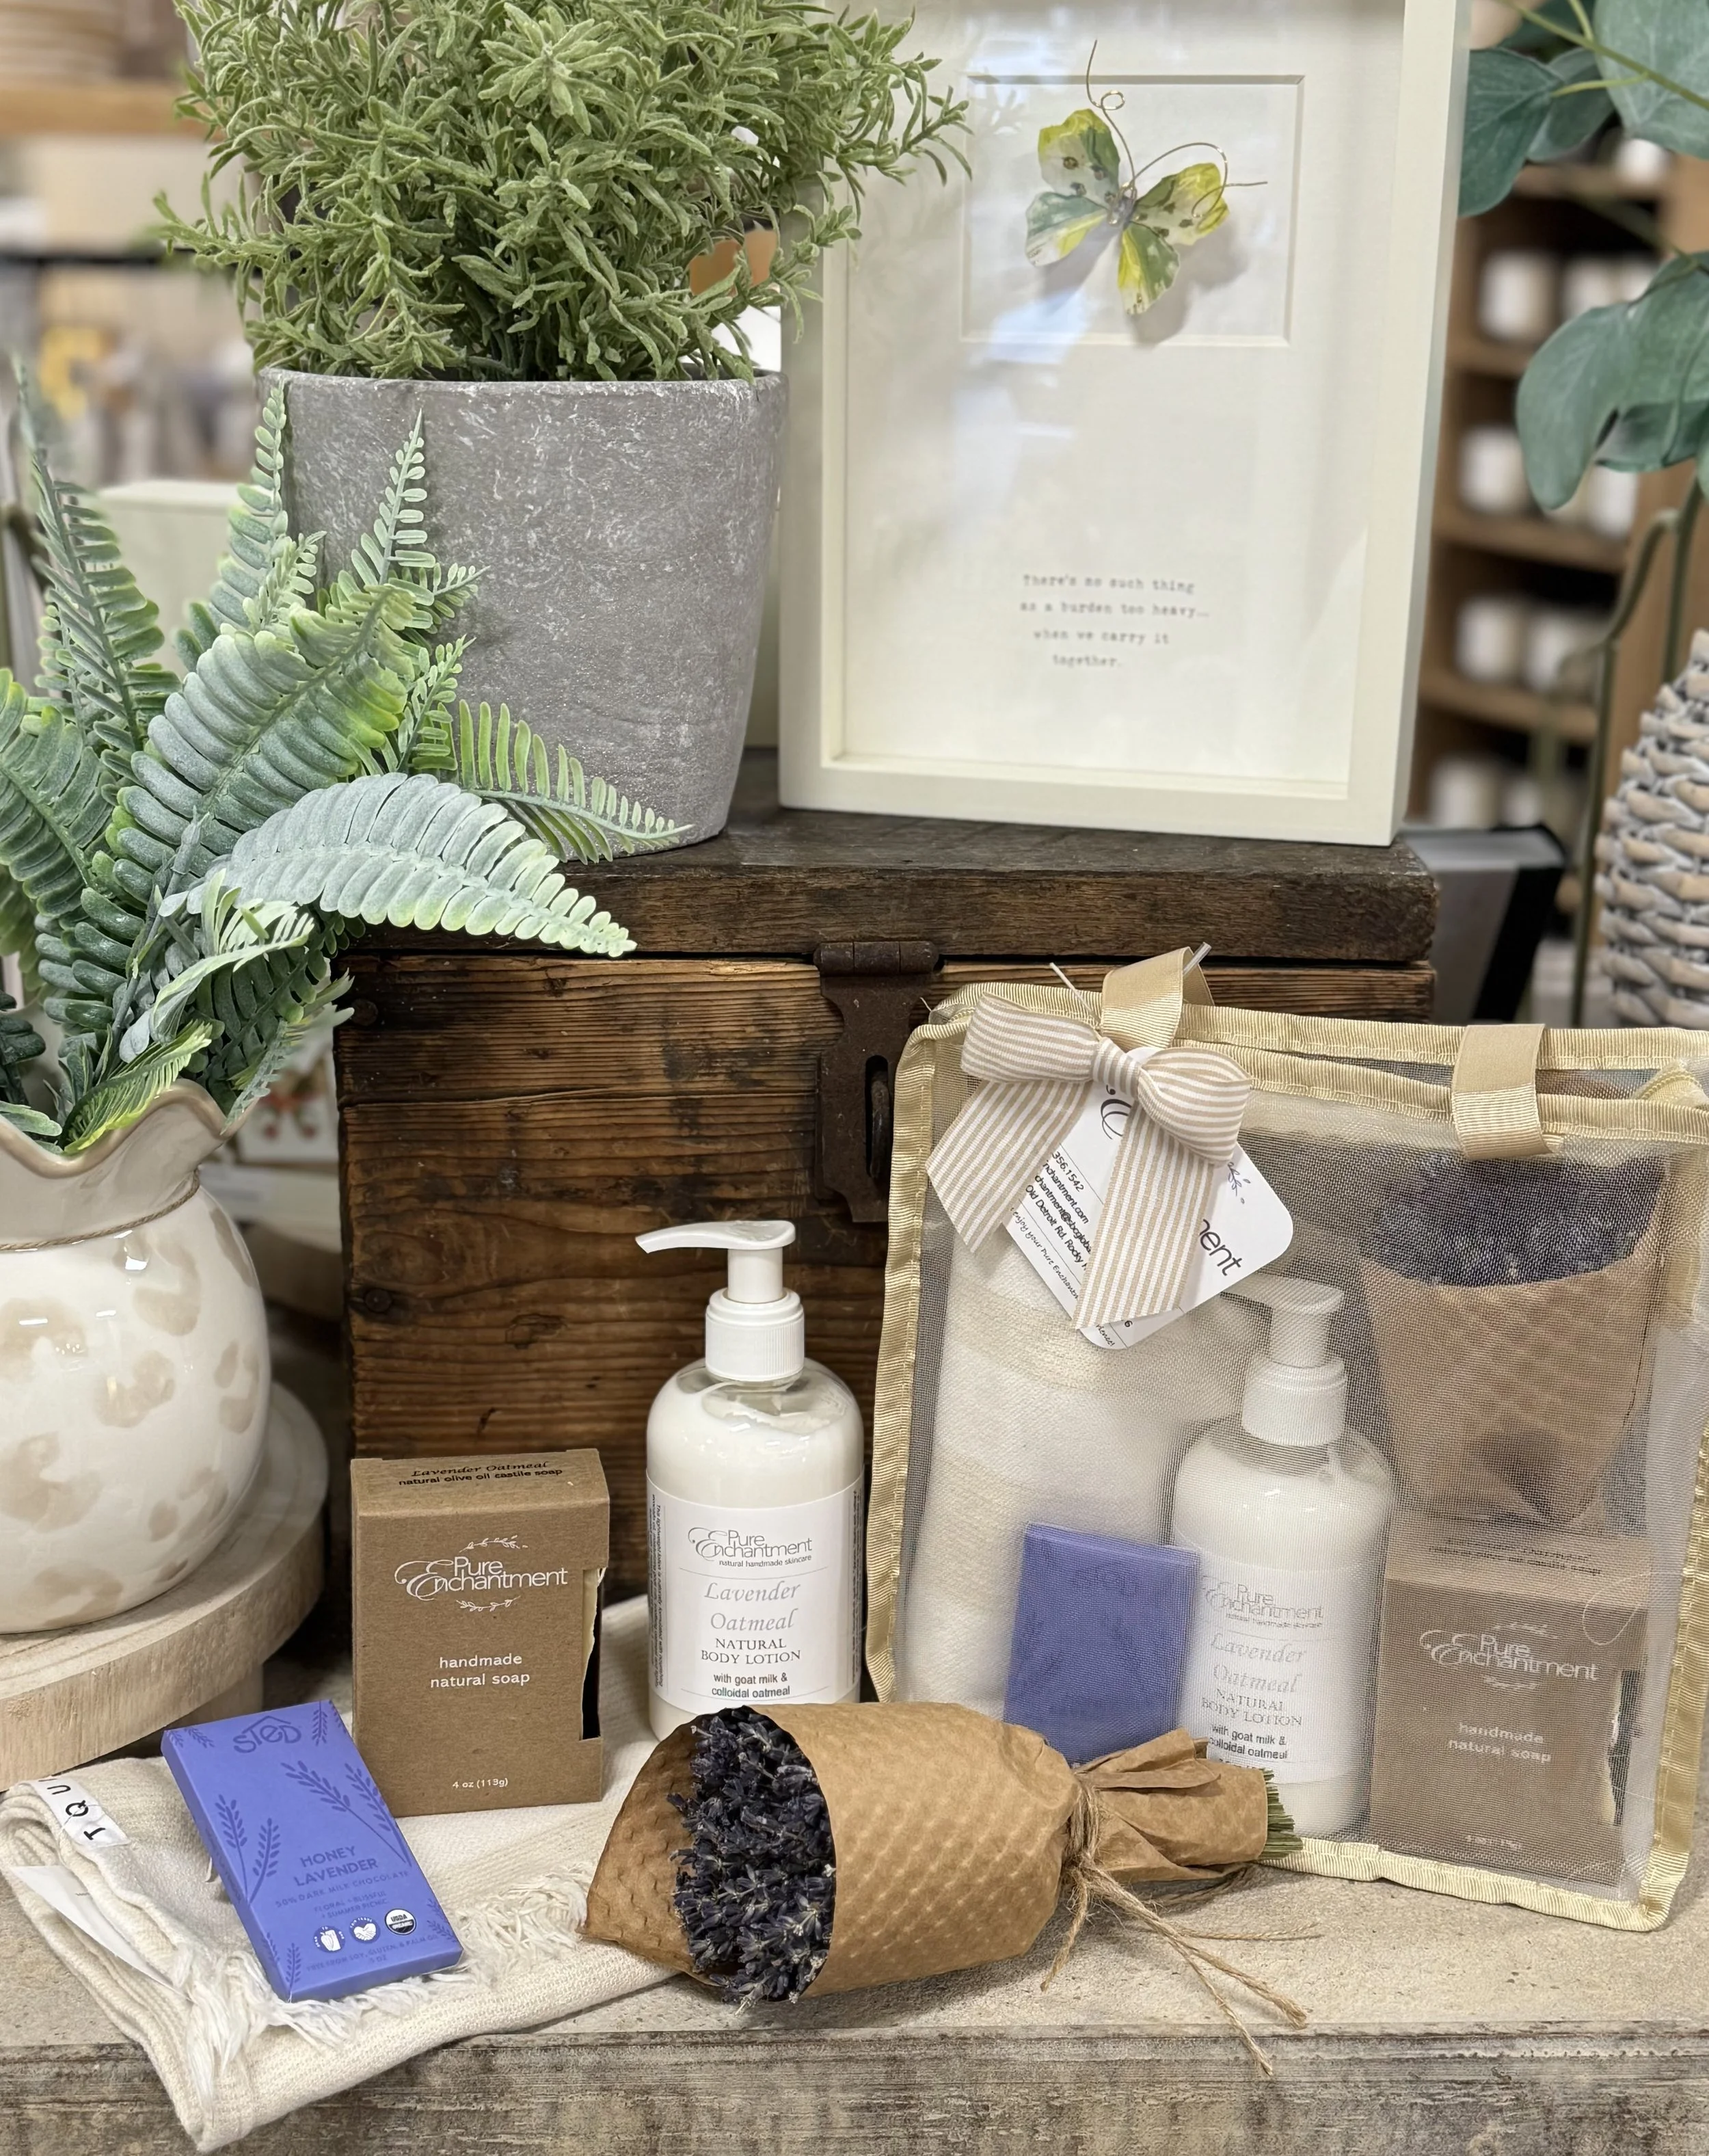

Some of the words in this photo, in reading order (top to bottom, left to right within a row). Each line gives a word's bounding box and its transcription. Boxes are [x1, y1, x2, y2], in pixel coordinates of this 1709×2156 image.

[1023, 574, 1077, 587] There's
[1084, 577, 1102, 588] no
[1109, 577, 1144, 590] such
[1152, 579, 1196, 595] thing
[1045, 602, 1053, 612] a
[1061, 601, 1112, 615] burden
[1120, 602, 1145, 615] too
[1033, 629, 1069, 640] when
[1076, 630, 1094, 641] we
[1101, 631, 1146, 646] carry
[1154, 632, 1170, 644] it
[1041, 1159, 1089, 1225] nchantment.com
[1025, 1184, 1039, 1201] Old
[1036, 1199, 1058, 1227] Detroit
[1054, 1225, 1064, 1240] Rd.
[1064, 1239, 1084, 1264] Rocky
[1034, 1175, 1092, 1255] chantment@sbcgloba
[1012, 1210, 1029, 1232] enjoy
[1025, 1230, 1042, 1249] your
[1041, 1247, 1054, 1266] Pure
[399, 1476, 440, 1486] natural
[444, 1474, 472, 1482] olive
[494, 1470, 531, 1479] castile
[535, 1469, 563, 1477] soap
[411, 1465, 481, 1478] Lavender
[486, 1461, 549, 1472] Oatmeal
[688, 1527, 812, 1561] Enchantment
[728, 1530, 765, 1547] Pure
[454, 1556, 503, 1576] Pure
[718, 1559, 744, 1567] natural
[745, 1559, 783, 1567] handmade
[785, 1554, 812, 1565] skincare
[394, 1559, 568, 1601] Enchantment
[703, 1580, 800, 1601] Lavender
[1235, 1584, 1274, 1605] Pure
[710, 1608, 798, 1631] Oatmeal
[715, 1638, 786, 1650] NATURAL
[1210, 1632, 1308, 1663] Lavender
[1479, 1634, 1531, 1658] Pure
[439, 1653, 522, 1669] handmade
[701, 1650, 740, 1664] BODY
[746, 1650, 801, 1664] LOTION
[1419, 1629, 1599, 1681] Enchantment
[430, 1673, 486, 1688] natural
[492, 1672, 530, 1687] soap
[713, 1673, 731, 1683] with
[734, 1674, 756, 1685] goat
[759, 1673, 778, 1683] milk
[781, 1673, 788, 1682] &
[1213, 1663, 1303, 1693] Oatmeal
[712, 1686, 749, 1698] colloidal
[752, 1686, 790, 1698] oatmeal
[1215, 1688, 1284, 1711] NATURAL
[1244, 1711, 1303, 1726] LOTION
[1211, 1724, 1229, 1736] with
[1231, 1730, 1254, 1743] goat
[1256, 1734, 1276, 1745] milk
[1459, 1722, 1544, 1744] handmade
[1209, 1737, 1246, 1755] colloidal
[1248, 1748, 1288, 1759] oatmeal
[1448, 1738, 1505, 1756] natural
[1510, 1746, 1552, 1764] soap
[452, 1781, 459, 1789] 4
[476, 1777, 509, 1789] (113g)
[299, 1846, 355, 1868] HONEY
[293, 1857, 379, 1887] LAVENDER
[299, 1889, 325, 1901] DARK
[328, 1882, 351, 1894] MILK
[353, 1870, 409, 1888] CHOCOLATE
